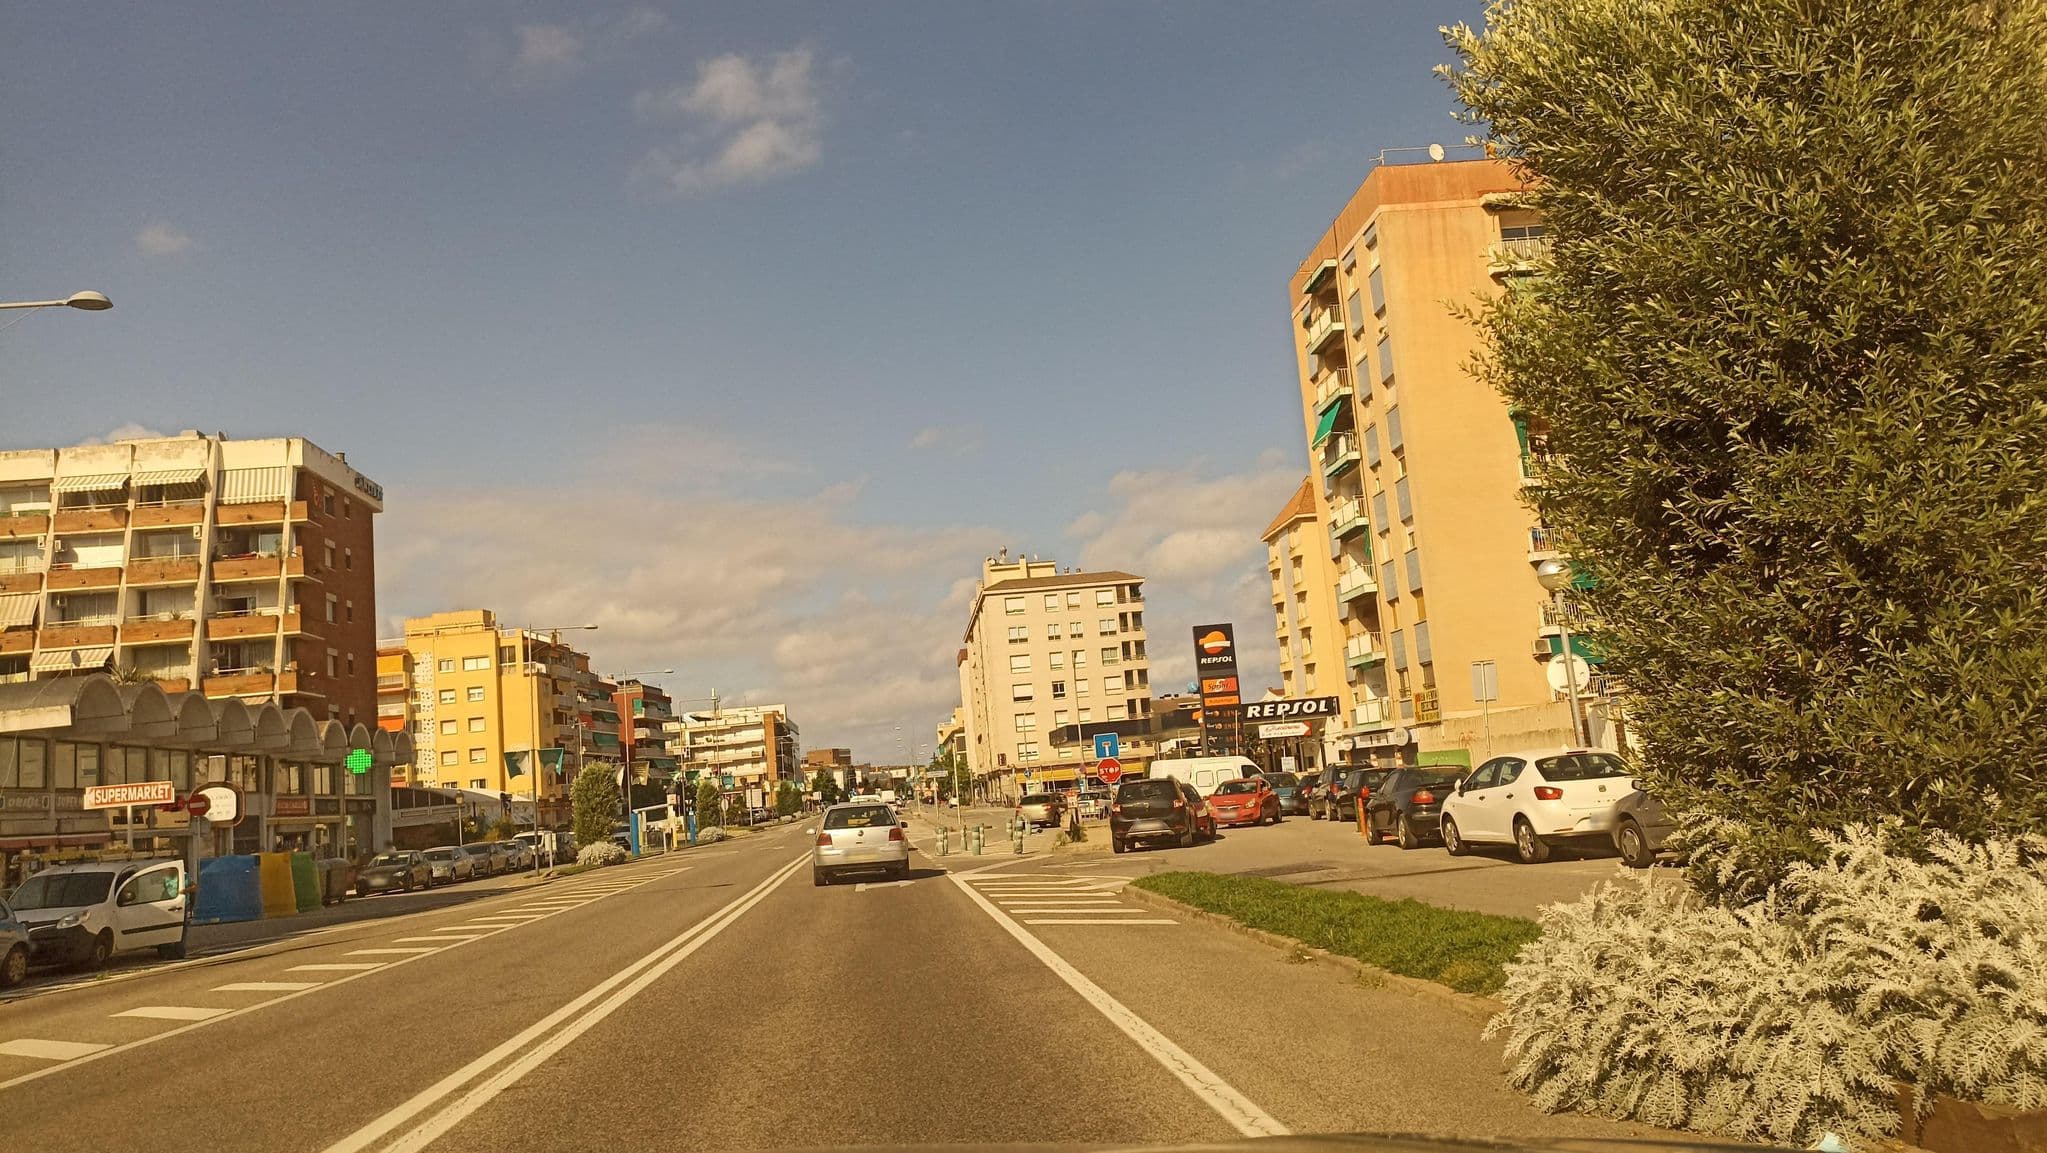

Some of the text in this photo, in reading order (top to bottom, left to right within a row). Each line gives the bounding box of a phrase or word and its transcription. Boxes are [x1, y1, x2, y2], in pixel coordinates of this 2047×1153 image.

[1201, 656, 1232, 664] REPSOL
[1247, 700, 1328, 718] REPSOL
[95, 784, 171, 804] SUPERMARKET
